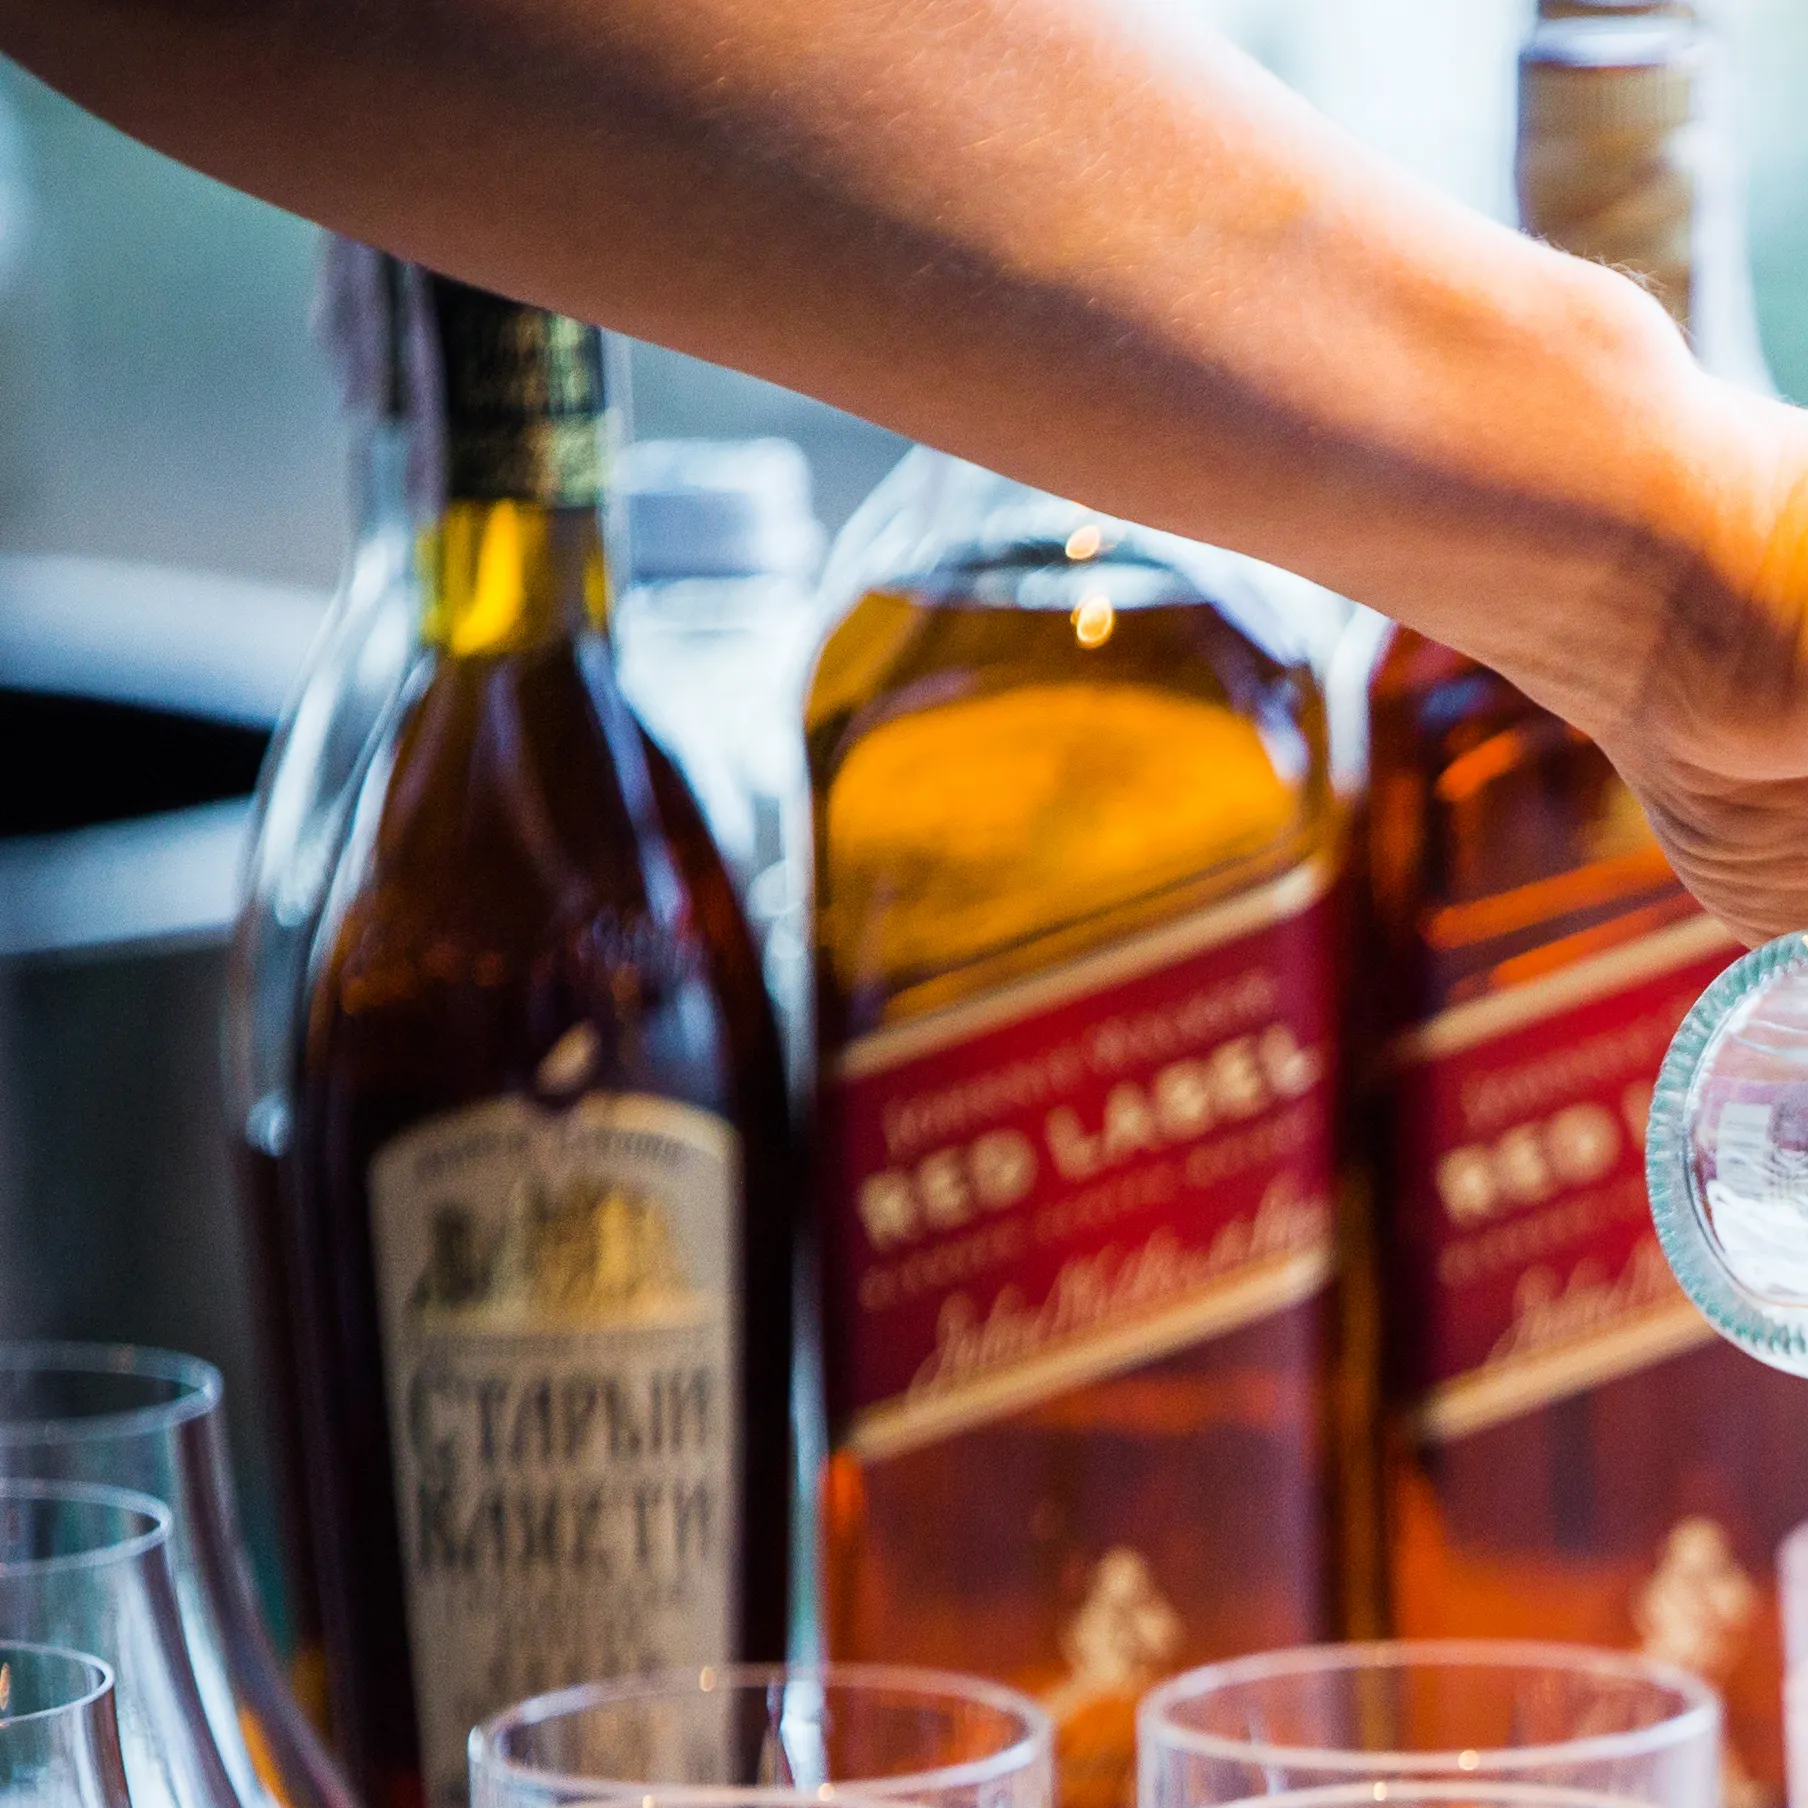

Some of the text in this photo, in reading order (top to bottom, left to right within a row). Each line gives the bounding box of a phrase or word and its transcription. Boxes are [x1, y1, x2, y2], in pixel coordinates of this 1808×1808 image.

[858, 1128, 1038, 1252] RED
[1043, 1022, 1325, 1182] LABEL
[1436, 1100, 1620, 1228] RED
